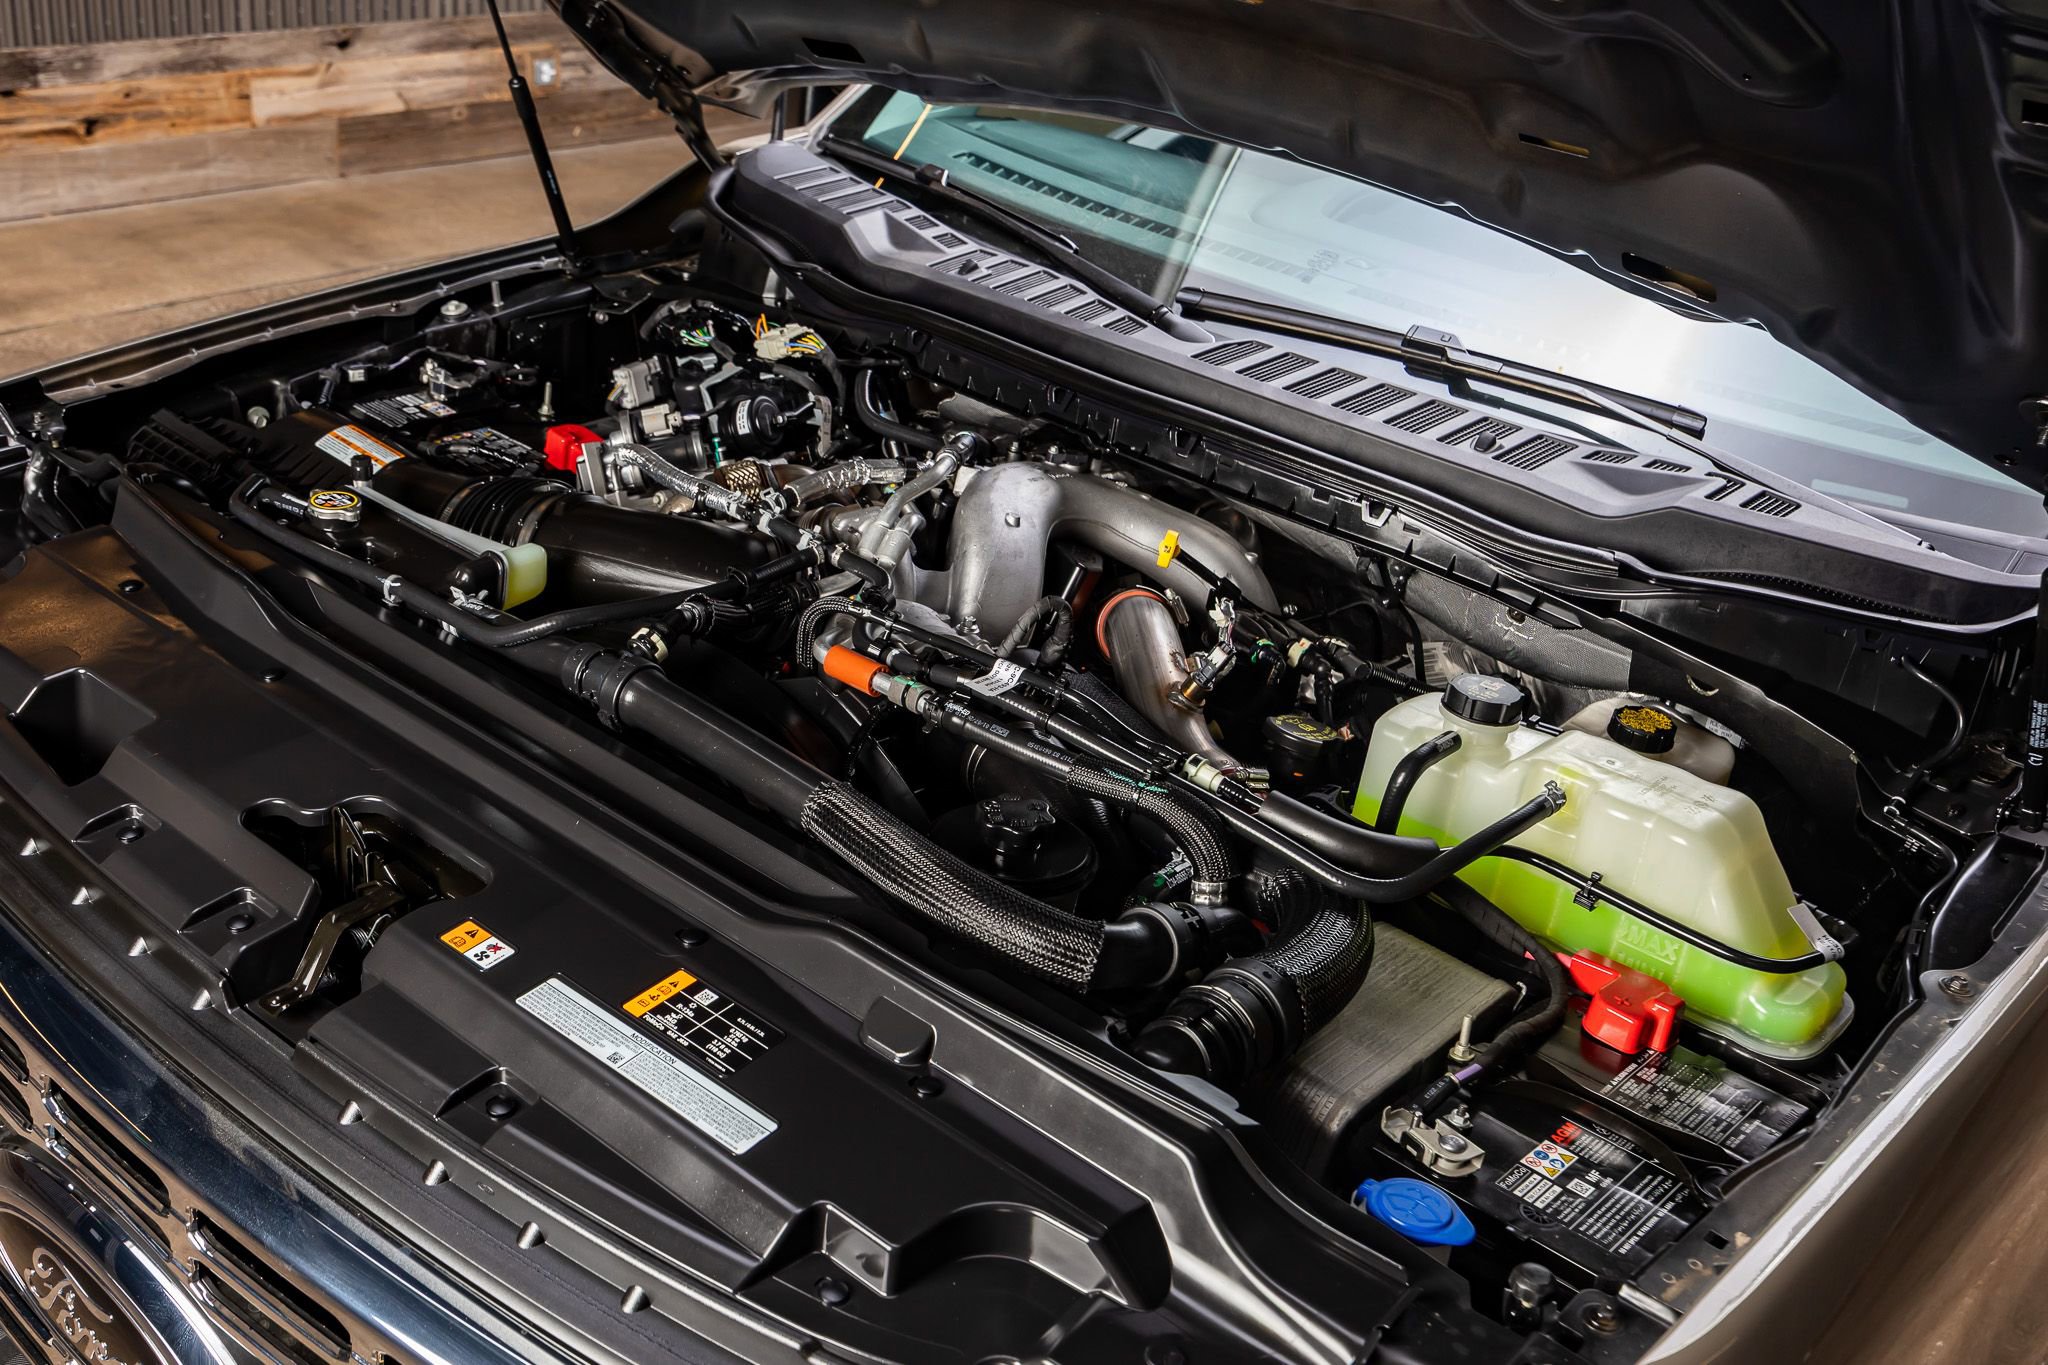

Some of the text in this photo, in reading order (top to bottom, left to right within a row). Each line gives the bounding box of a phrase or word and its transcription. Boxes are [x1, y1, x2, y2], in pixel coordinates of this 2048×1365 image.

[1629, 925, 1680, 961] MAX
[630, 1032, 677, 1065] MODIFICATION
[1551, 1121, 1576, 1144] AGM
[1501, 1167, 1526, 1189] FoMoCo
